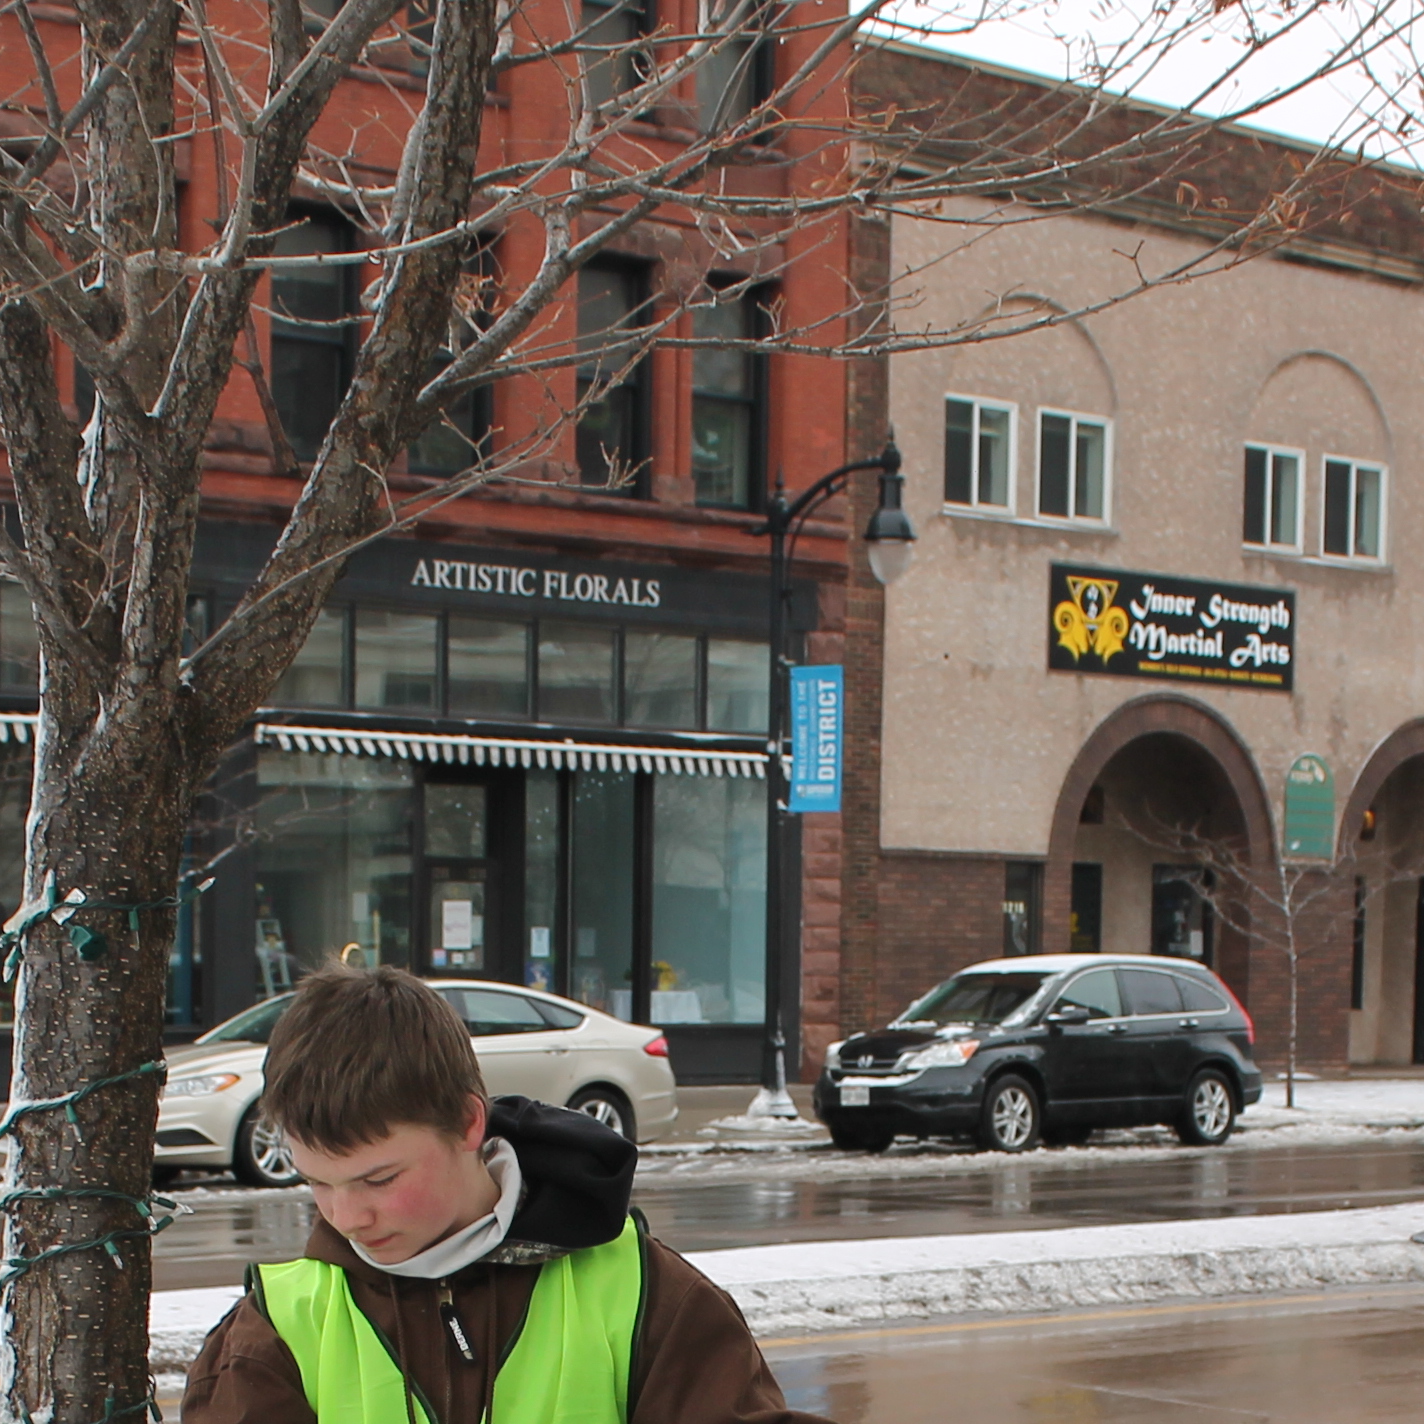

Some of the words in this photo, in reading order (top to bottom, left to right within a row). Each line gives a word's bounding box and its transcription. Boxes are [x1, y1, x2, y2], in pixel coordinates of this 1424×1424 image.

[411, 559, 536, 597] ARTISTIC
[543, 570, 660, 607] FLORALS
[1130, 584, 1196, 620] Inner
[1200, 594, 1290, 634] Strength
[1129, 622, 1224, 660] Martial
[1230, 633, 1290, 667] Arts
[817, 679, 836, 781] DISTRICT
[449, 1316, 470, 1351] BERNE
